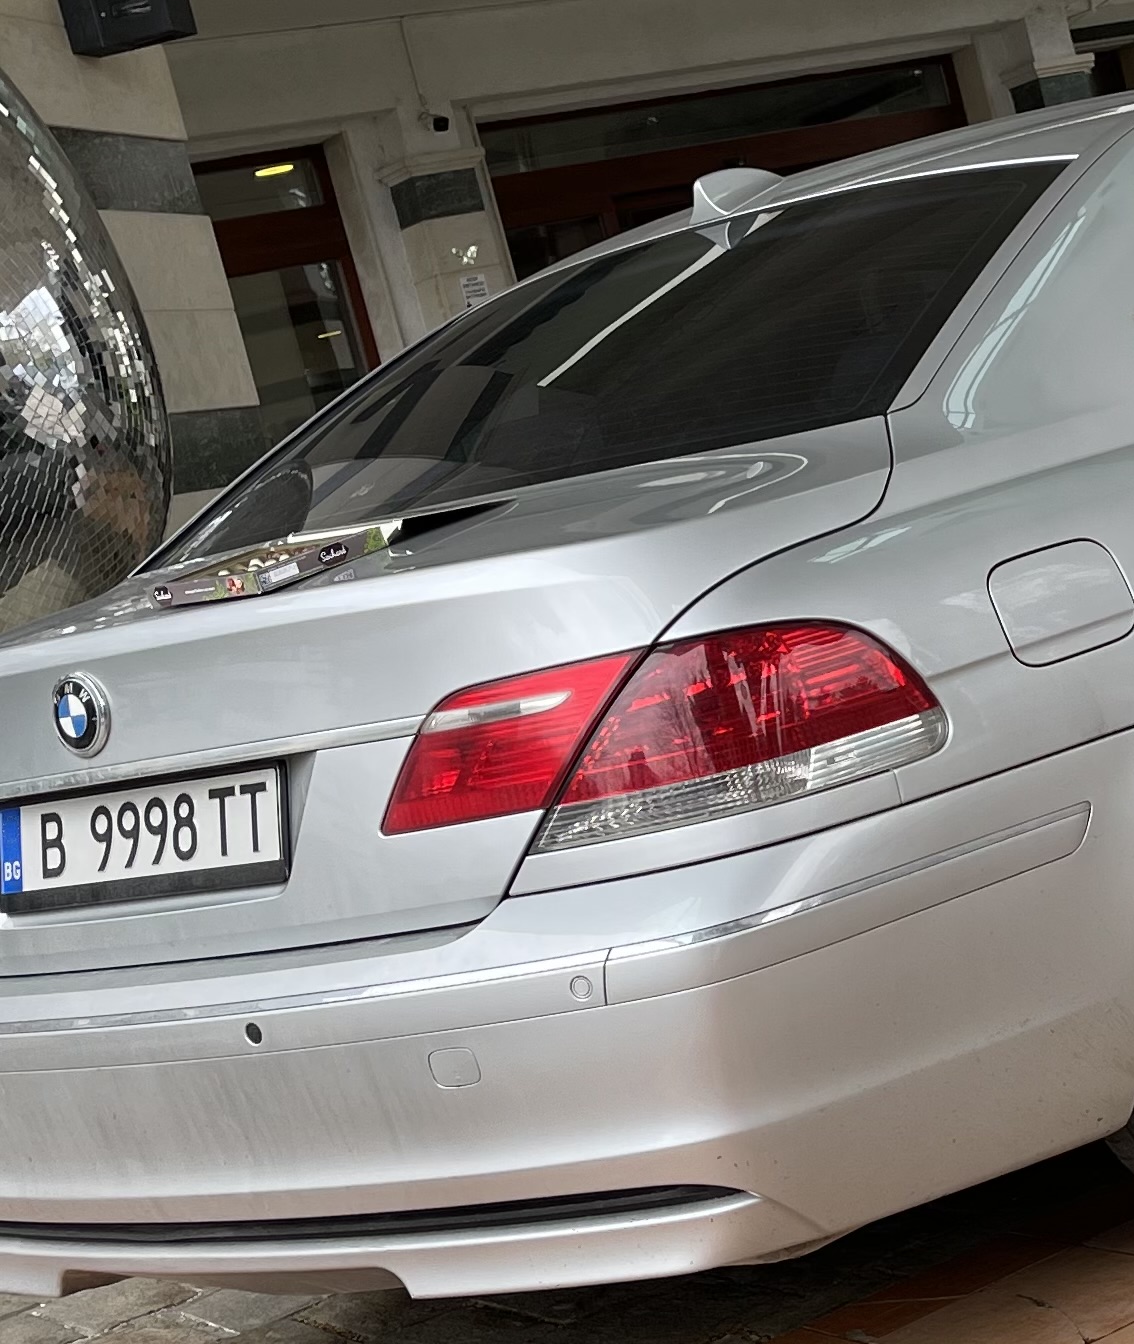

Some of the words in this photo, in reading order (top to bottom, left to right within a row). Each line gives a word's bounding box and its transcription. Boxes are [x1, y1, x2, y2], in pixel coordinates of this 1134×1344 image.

[41, 812, 66, 879] B
[90, 793, 198, 872] 9998
[208, 781, 267, 857] TT
[4, 861, 20, 881] BG
